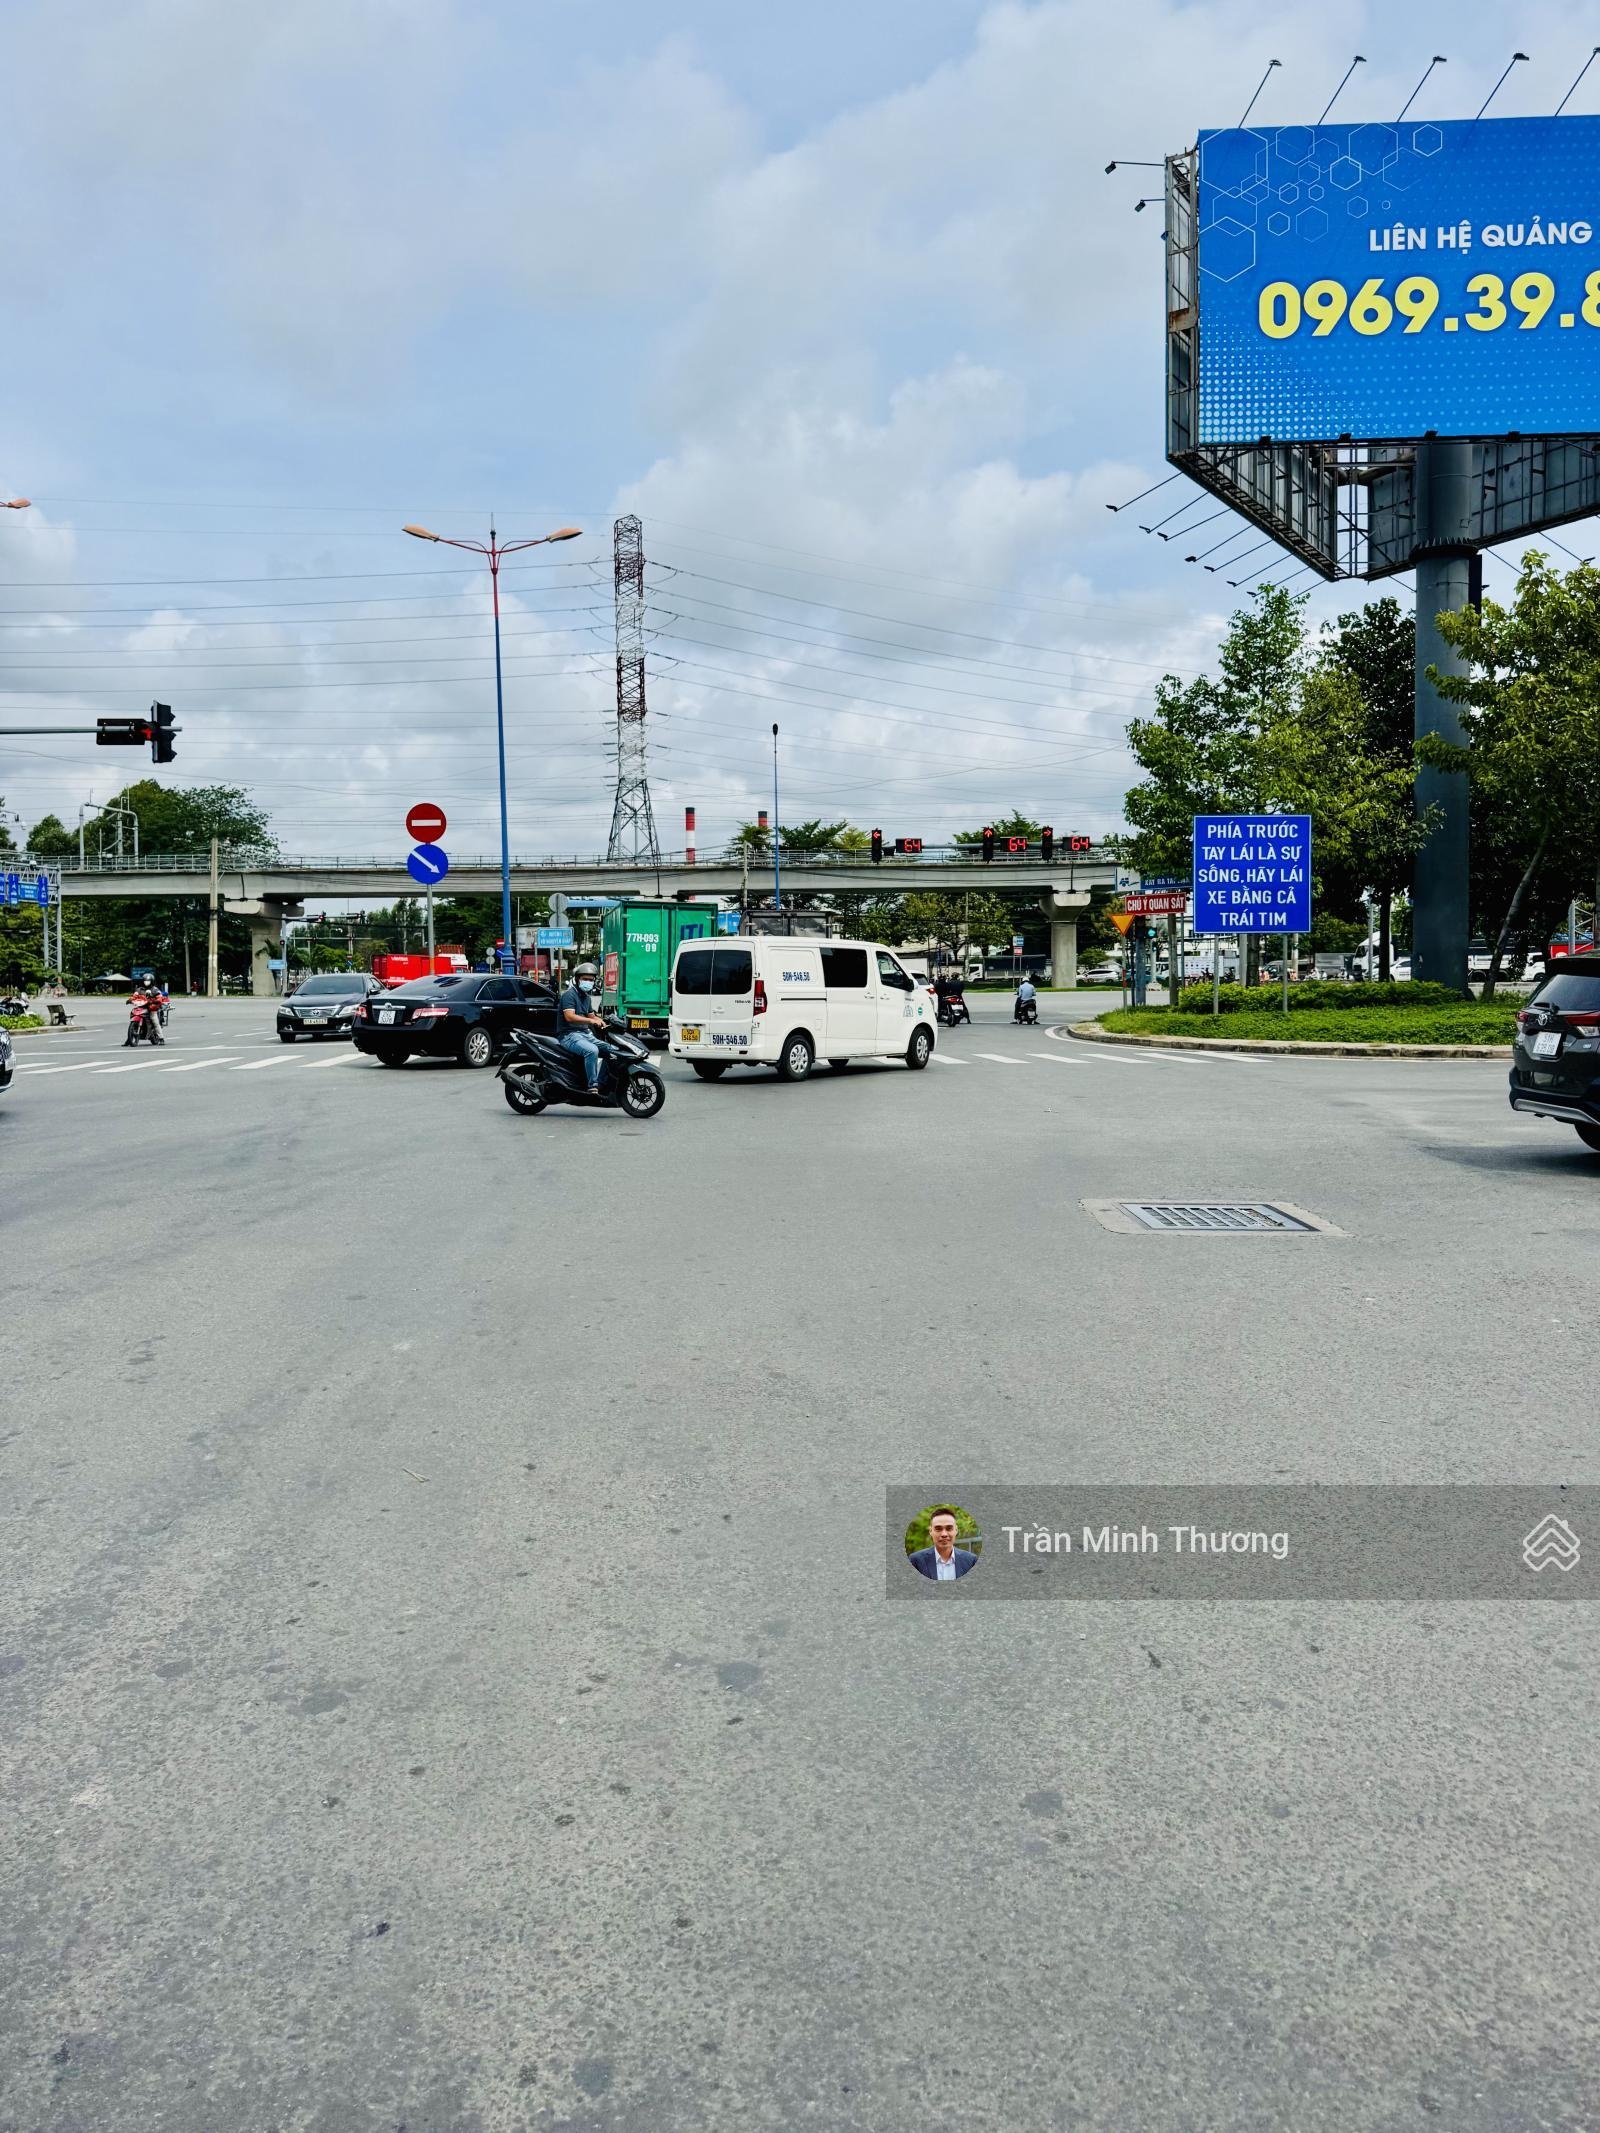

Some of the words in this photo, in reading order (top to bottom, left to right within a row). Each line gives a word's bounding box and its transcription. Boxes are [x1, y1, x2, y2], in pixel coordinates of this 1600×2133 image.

[1369, 222, 1427, 251] LIÊN
[1437, 219, 1472, 254] HỆ
[1481, 215, 1593, 248] QUẢNG
[1207, 820, 1242, 838] PHÍA
[1247, 820, 1298, 838] TRƯỚC
[904, 838, 921, 852] 64
[1009, 837, 1026, 852] 64
[1071, 836, 1088, 850] 64
[1202, 846, 1226, 860] TAY
[1231, 842, 1254, 860] LÁI
[1258, 842, 1276, 860] LÀ
[1281, 845, 1302, 862] SỰ
[1280, 864, 1303, 882] LÁI
[1127, 896, 1142, 911] CHÚ
[1143, 896, 1148, 911] Ý
[1149, 898, 1169, 911] QUAN
[1171, 895, 1185, 909] SÁT
[1207, 890, 1227, 904] XE
[1231, 885, 1272, 904] BẰNG
[1277, 886, 1296, 904] CẢ
[1220, 908, 1253, 926] TRÁI
[1258, 911, 1287, 926] TIM
[712, 1034, 748, 1045] 50H-546.50
